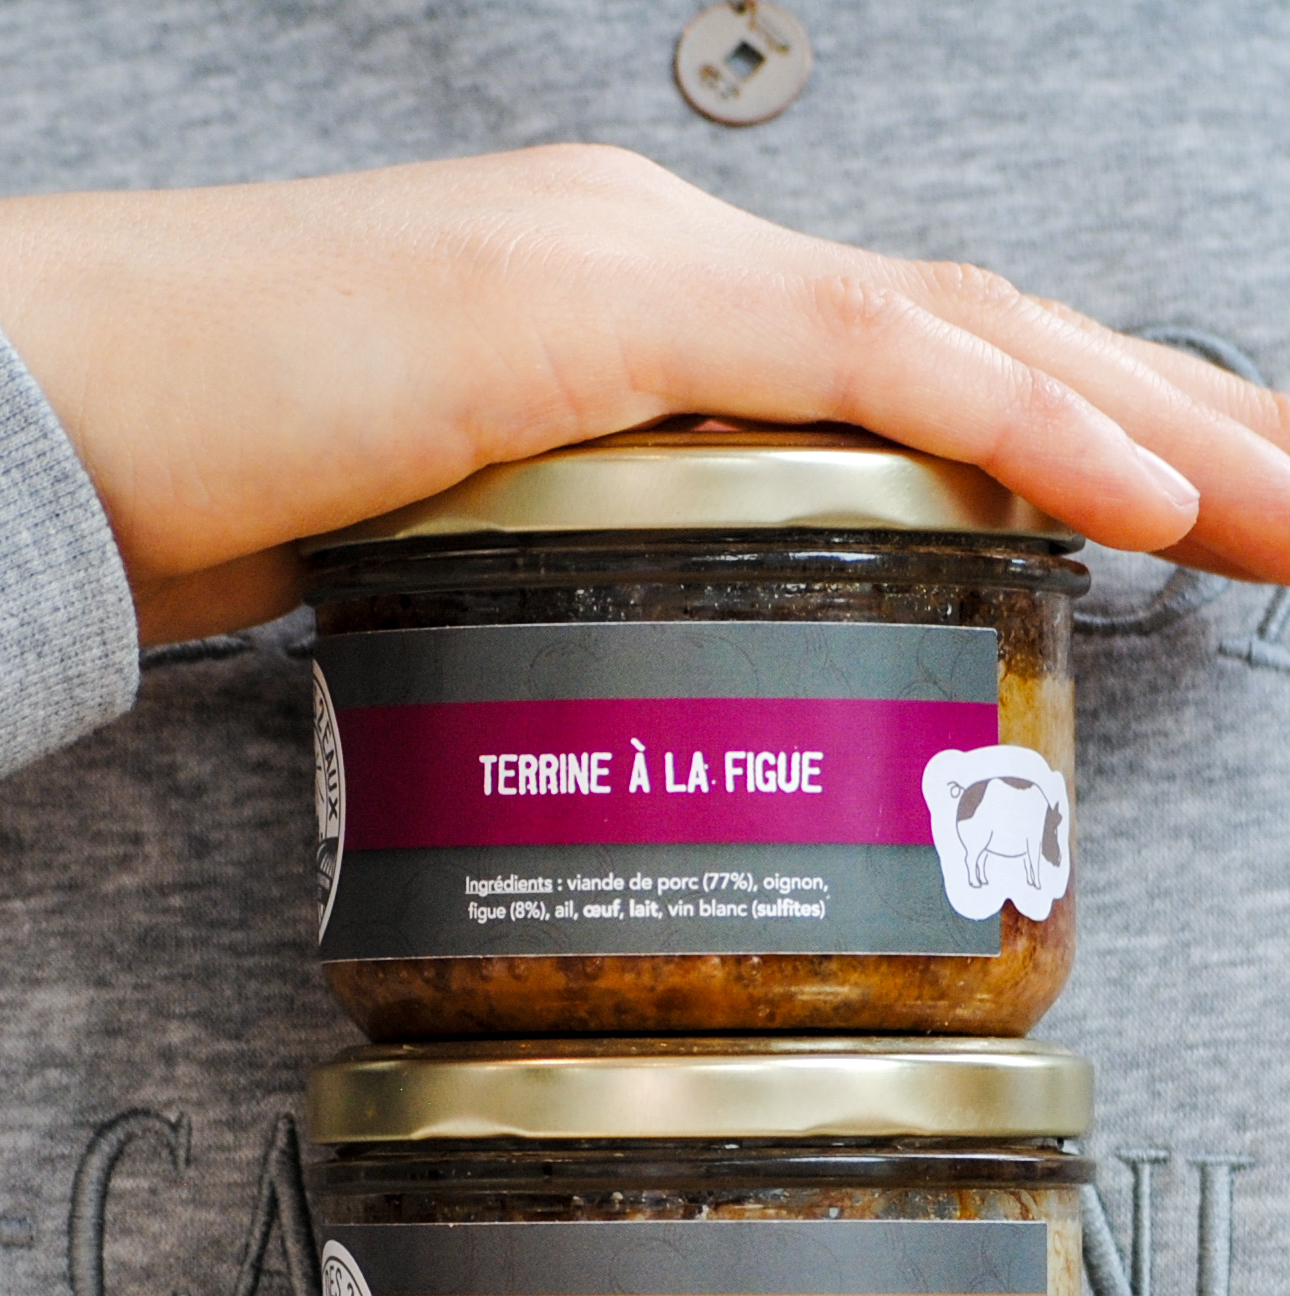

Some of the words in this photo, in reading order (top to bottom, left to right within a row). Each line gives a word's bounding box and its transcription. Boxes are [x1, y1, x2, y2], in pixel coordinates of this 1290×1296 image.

[479, 751, 612, 796] TERRINE
[629, 738, 650, 794] À
[665, 750, 708, 794] LA
[725, 748, 823, 794] FIGUE
[465, 873, 553, 897] Ingrédients
[567, 872, 624, 891] viande
[629, 872, 652, 890] de
[658, 875, 699, 896] porc
[702, 872, 758, 892] (77%),
[763, 873, 828, 894] oignon,
[467, 901, 506, 924] figue
[510, 900, 550, 921] (8%),
[555, 900, 579, 920] ail,
[583, 898, 624, 920] œuf,
[629, 899, 663, 920] lait,
[668, 900, 694, 917] vin
[699, 899, 748, 917] blanc
[752, 898, 825, 920] (sulfites)
